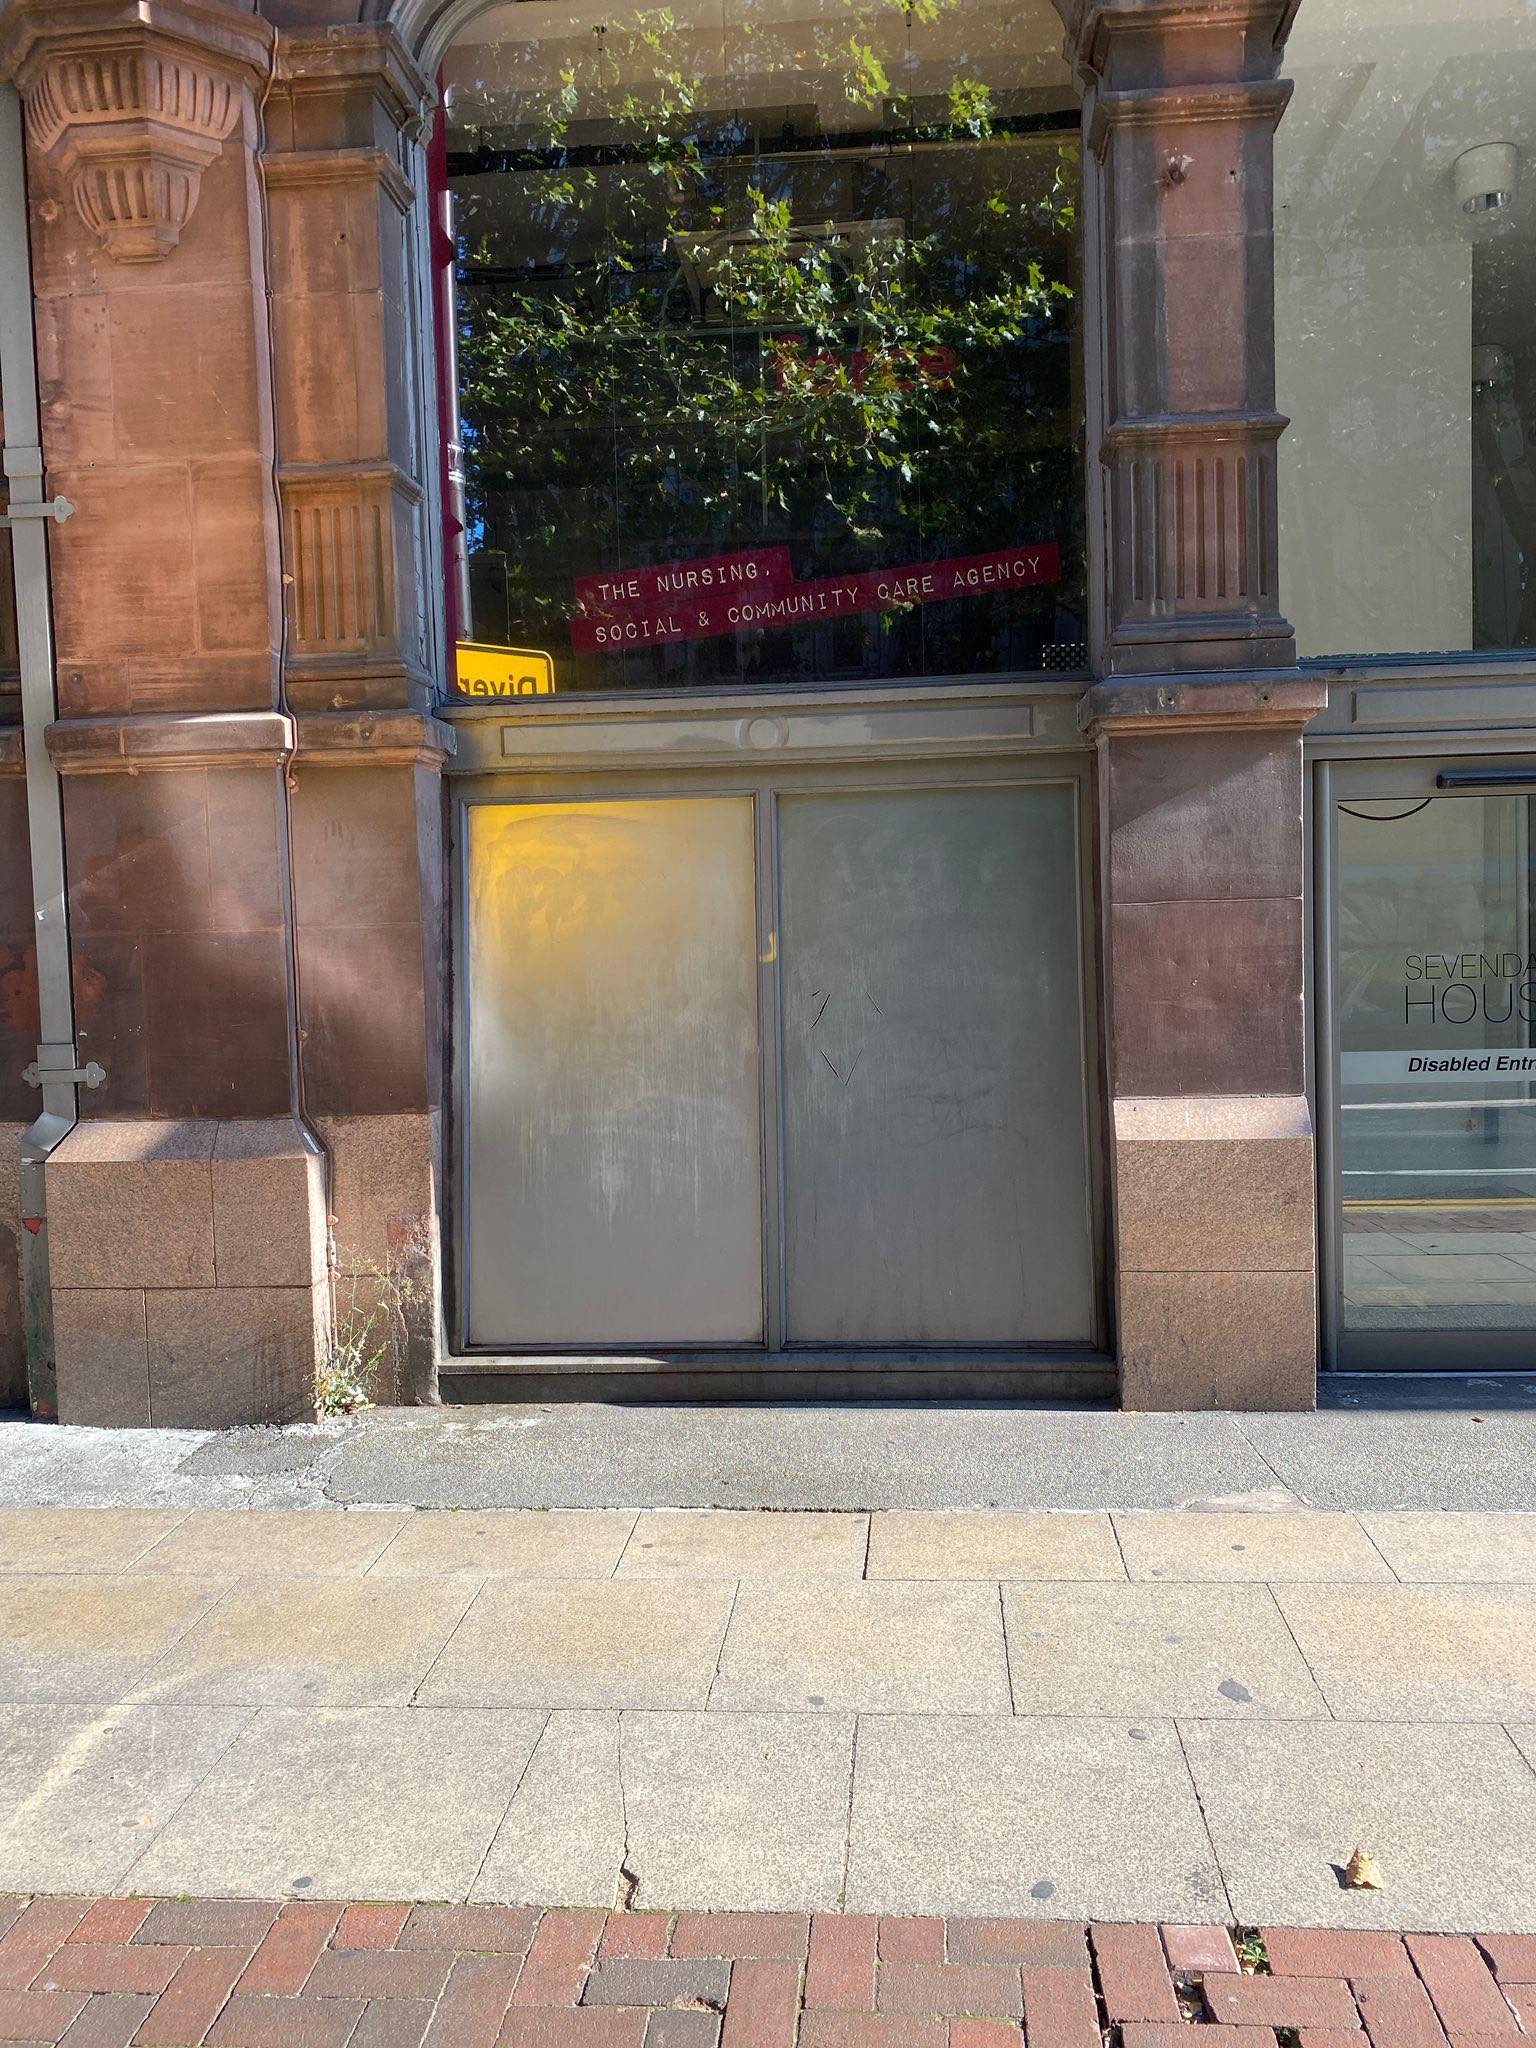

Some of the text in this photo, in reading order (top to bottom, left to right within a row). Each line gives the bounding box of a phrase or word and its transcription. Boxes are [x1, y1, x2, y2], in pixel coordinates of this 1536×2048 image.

[595, 557, 1040, 643] SOCIAL & COMMUNITY CARE AGENCY
[598, 580, 640, 601] THE
[1408, 1056, 1491, 1073] Disabled
